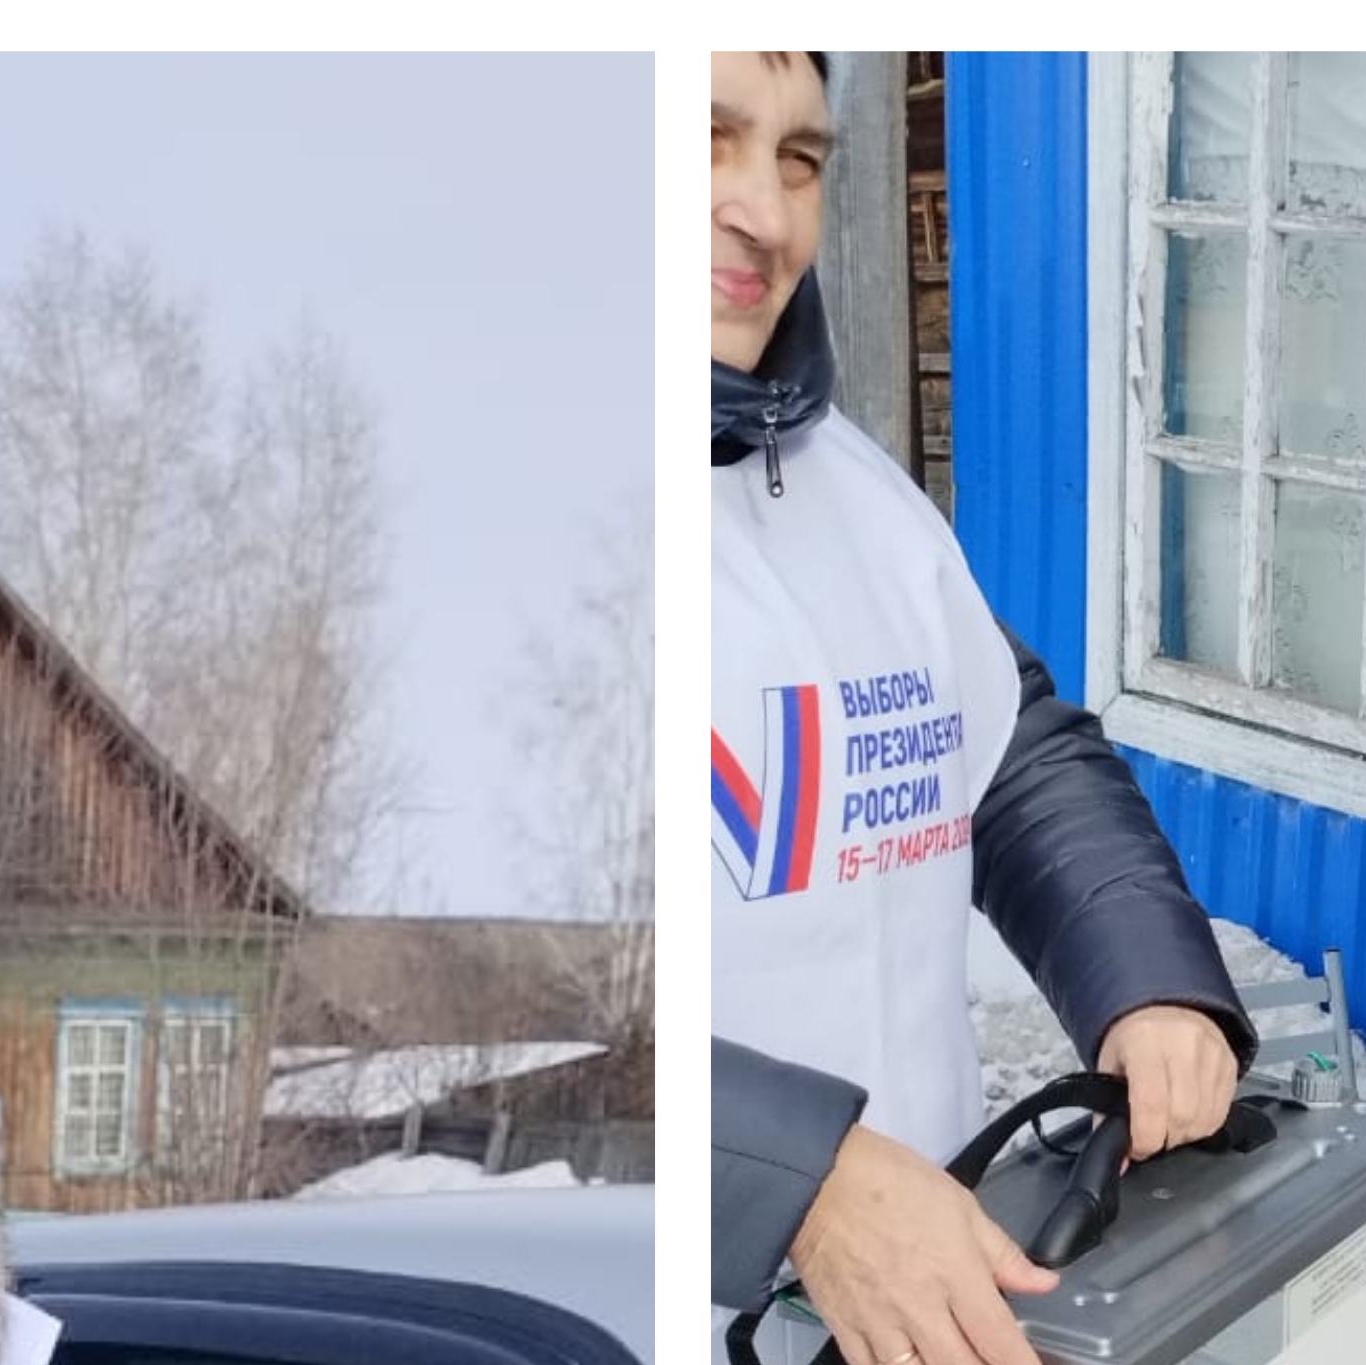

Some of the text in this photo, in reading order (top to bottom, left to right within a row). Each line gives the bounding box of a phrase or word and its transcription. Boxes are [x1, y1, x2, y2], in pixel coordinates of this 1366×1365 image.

[839, 667, 934, 719] ВЫБОРЫ
[842, 774, 941, 833] РОССИИ
[896, 821, 949, 868] МАРТА
